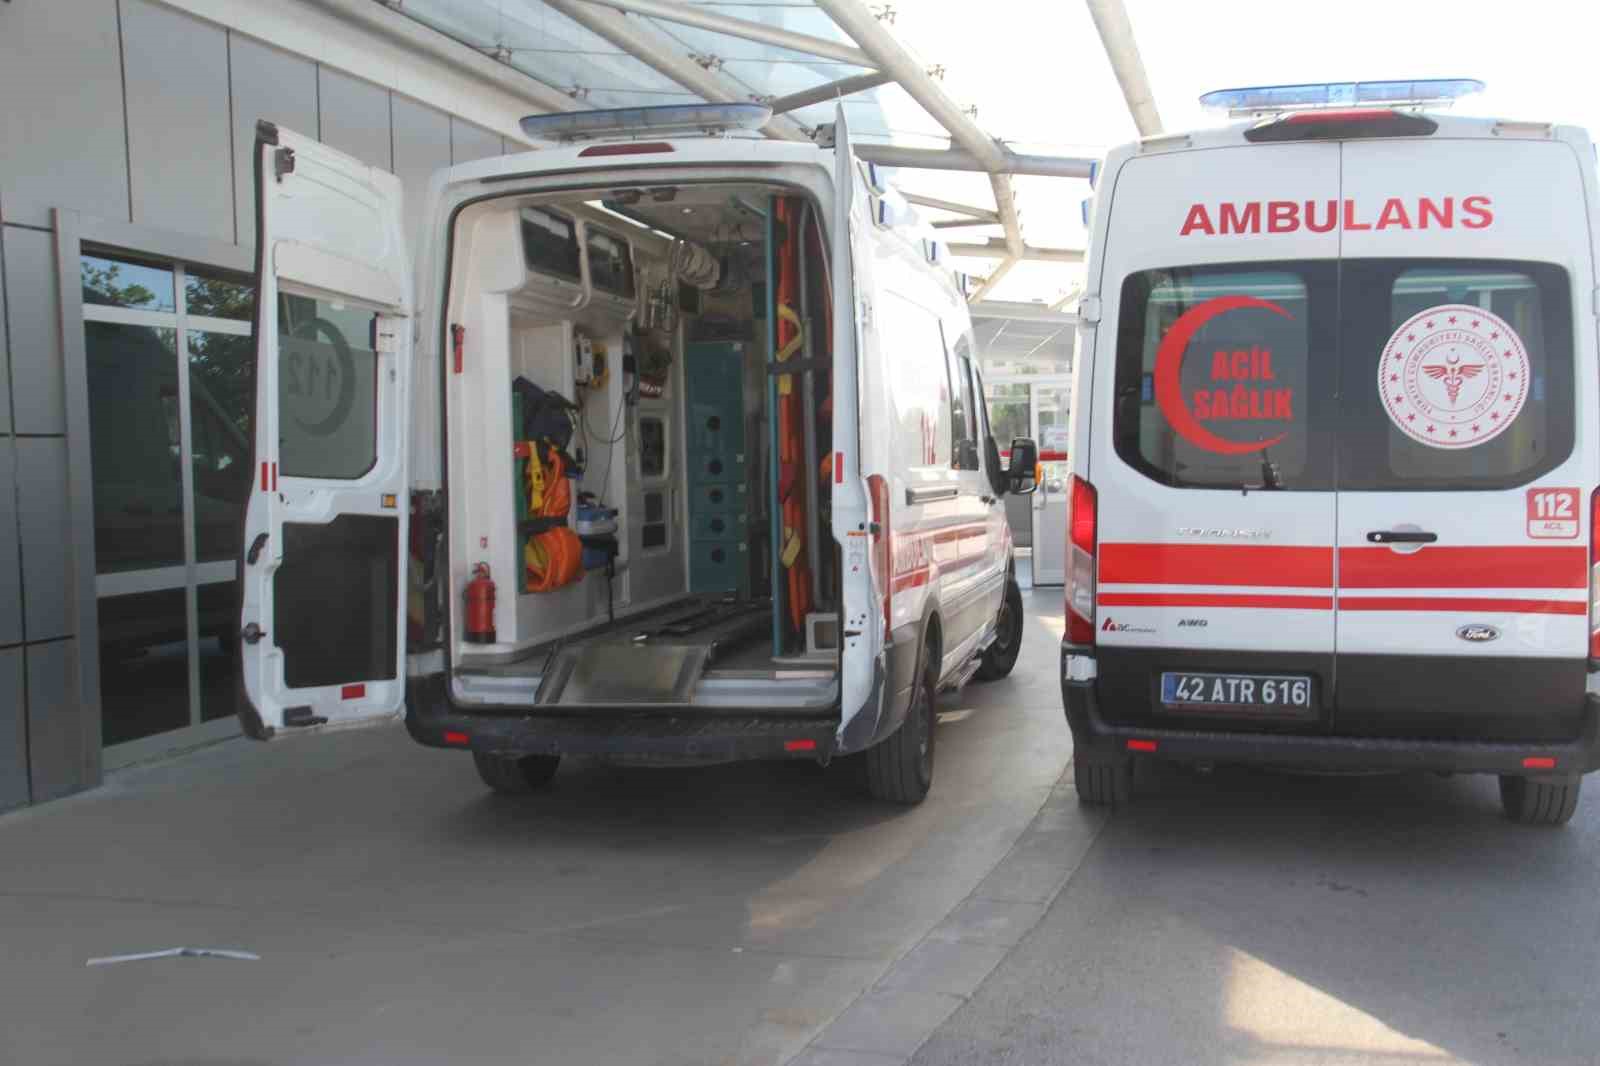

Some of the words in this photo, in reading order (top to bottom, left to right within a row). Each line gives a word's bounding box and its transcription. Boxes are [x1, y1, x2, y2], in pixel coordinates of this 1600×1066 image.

[1179, 195, 1495, 236] AMBULANS
[1193, 384, 1293, 420] SAĞLIK
[1534, 493, 1574, 518] 112
[1177, 618, 1208, 628] AWD
[1176, 677, 1205, 701] 42
[1211, 678, 1255, 703] ATR
[1262, 680, 1306, 705] 616
